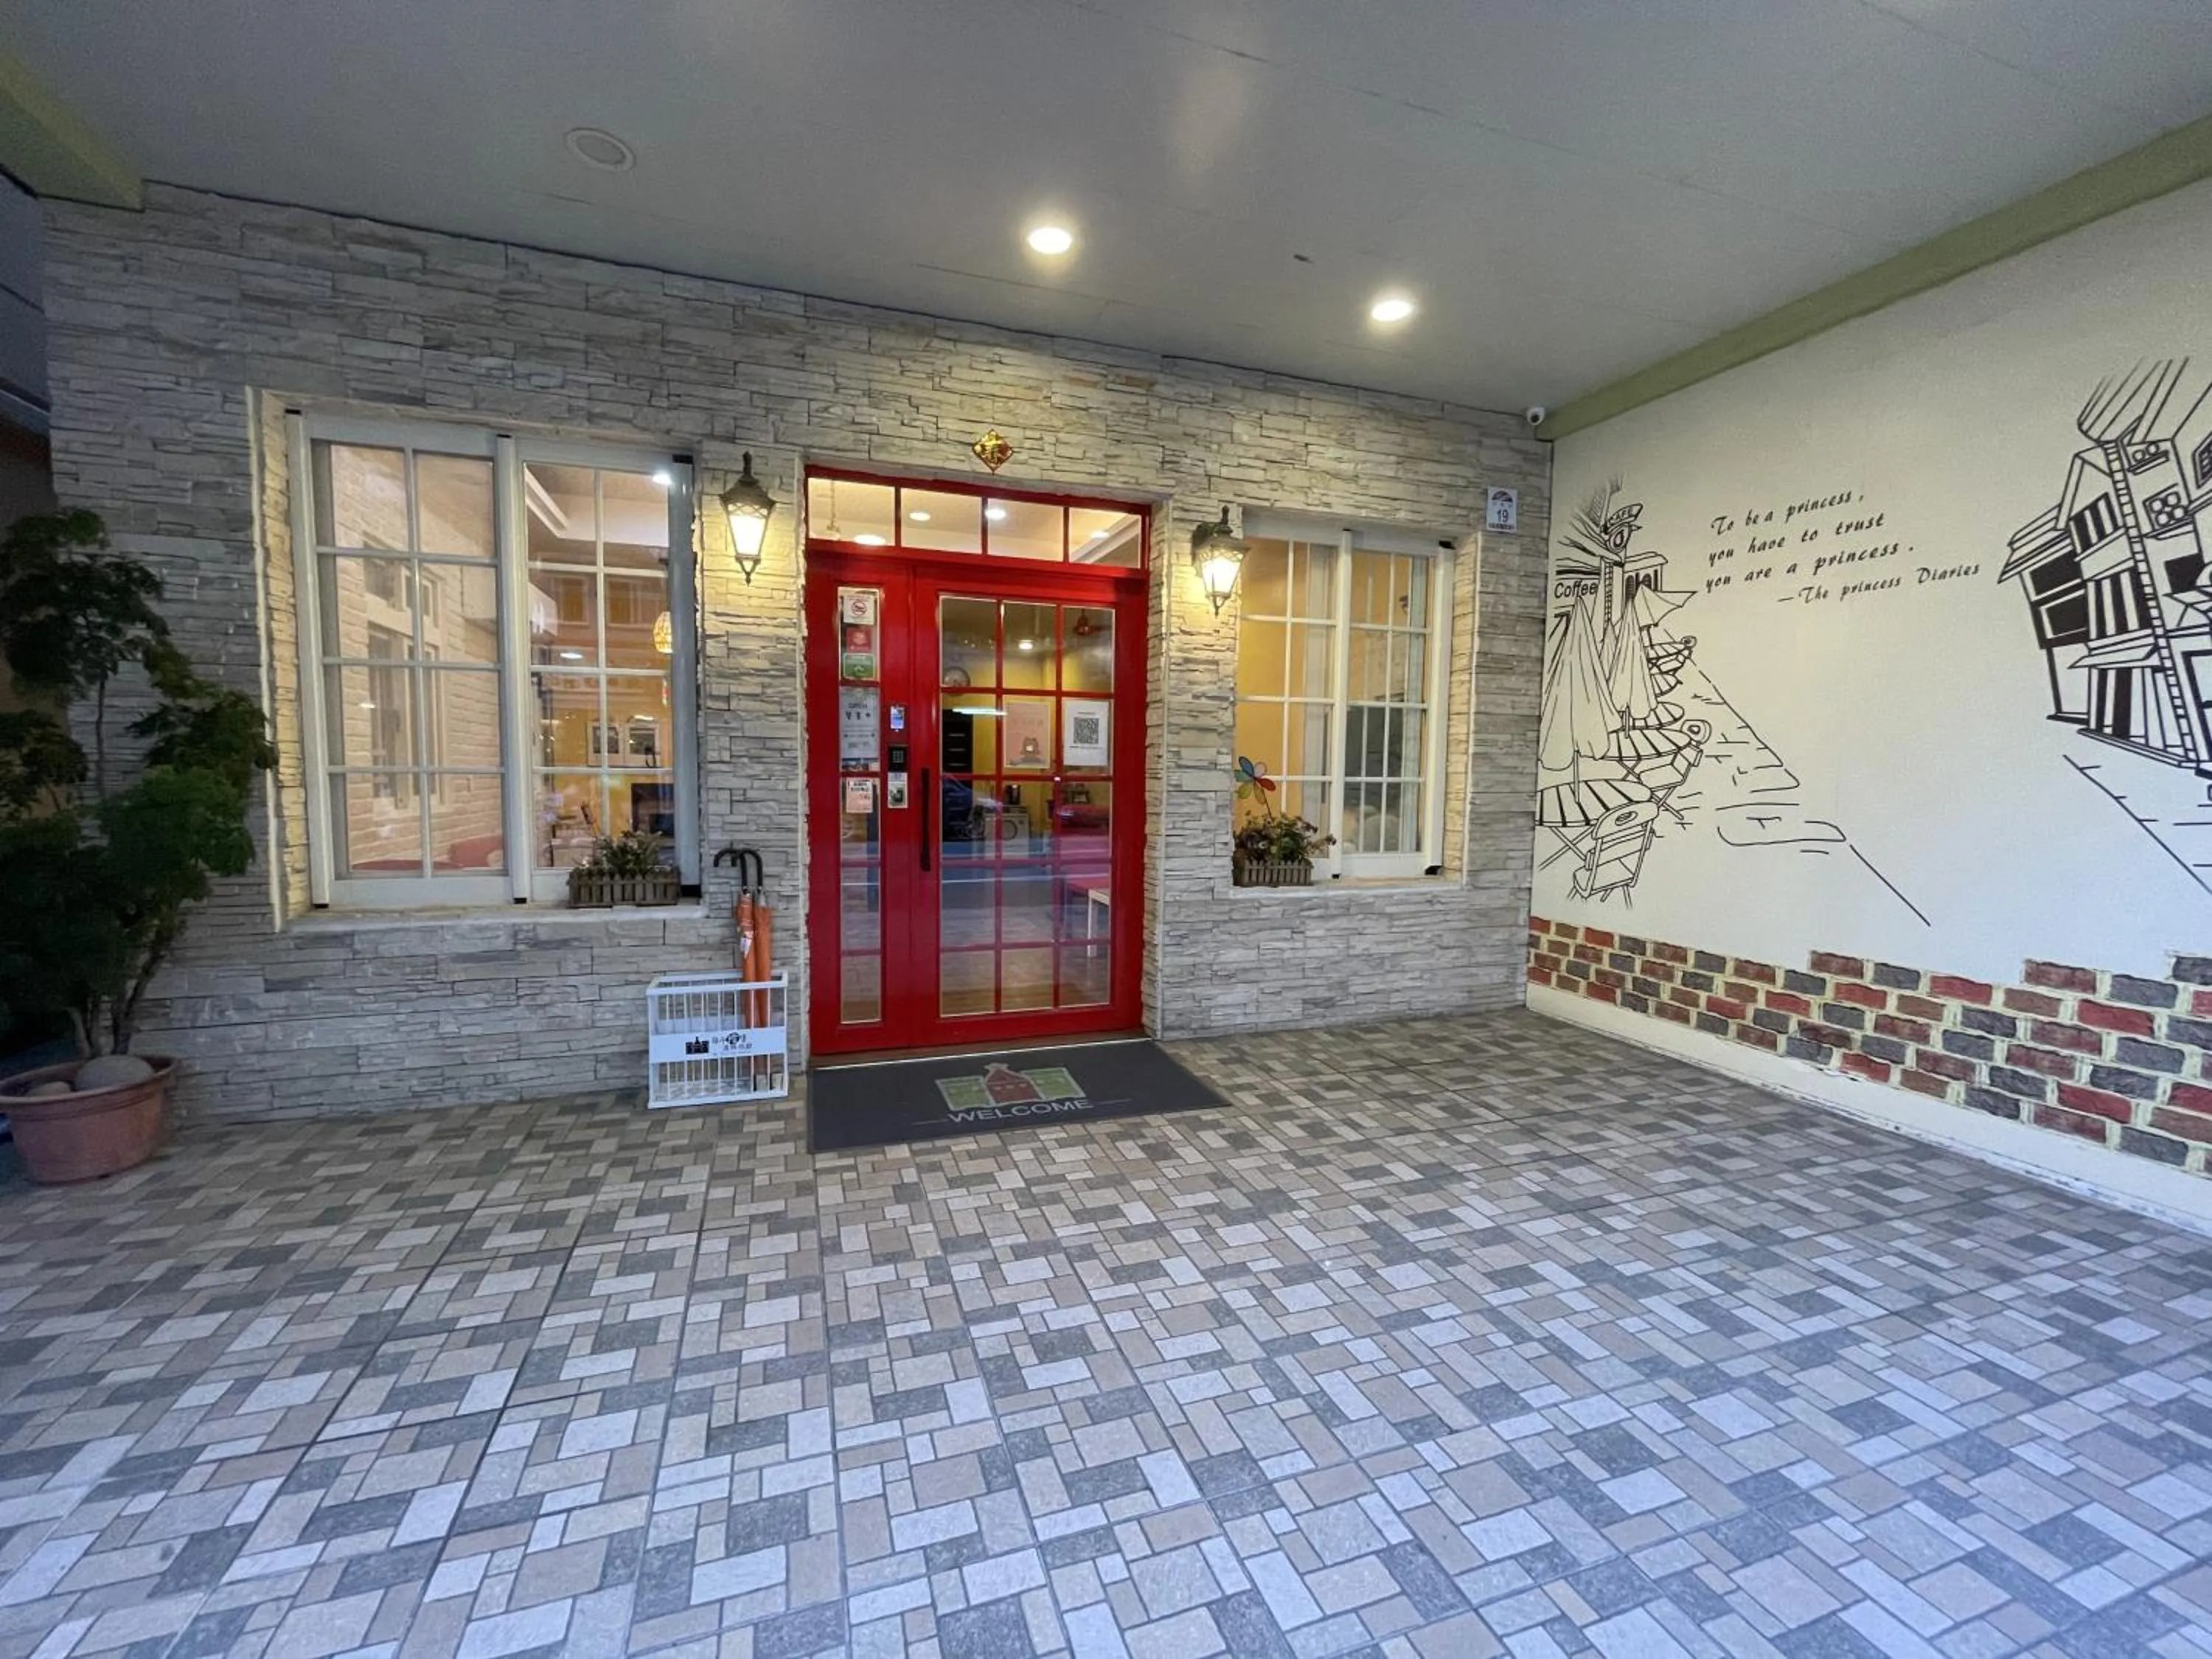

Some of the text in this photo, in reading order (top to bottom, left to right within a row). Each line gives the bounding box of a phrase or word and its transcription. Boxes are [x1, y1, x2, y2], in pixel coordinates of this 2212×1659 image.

[1497, 509, 1509, 523] 19
[1711, 515, 1734, 535] To
[1708, 512, 1885, 567] you have to trust
[1554, 580, 1599, 599] Coffee
[1705, 575, 1731, 594] you
[1745, 567, 1772, 582] are
[1787, 563, 1798, 574] a
[1840, 577, 1902, 602] princess
[1916, 564, 1980, 584] Diaries
[947, 1099, 1094, 1123] WELCOME
